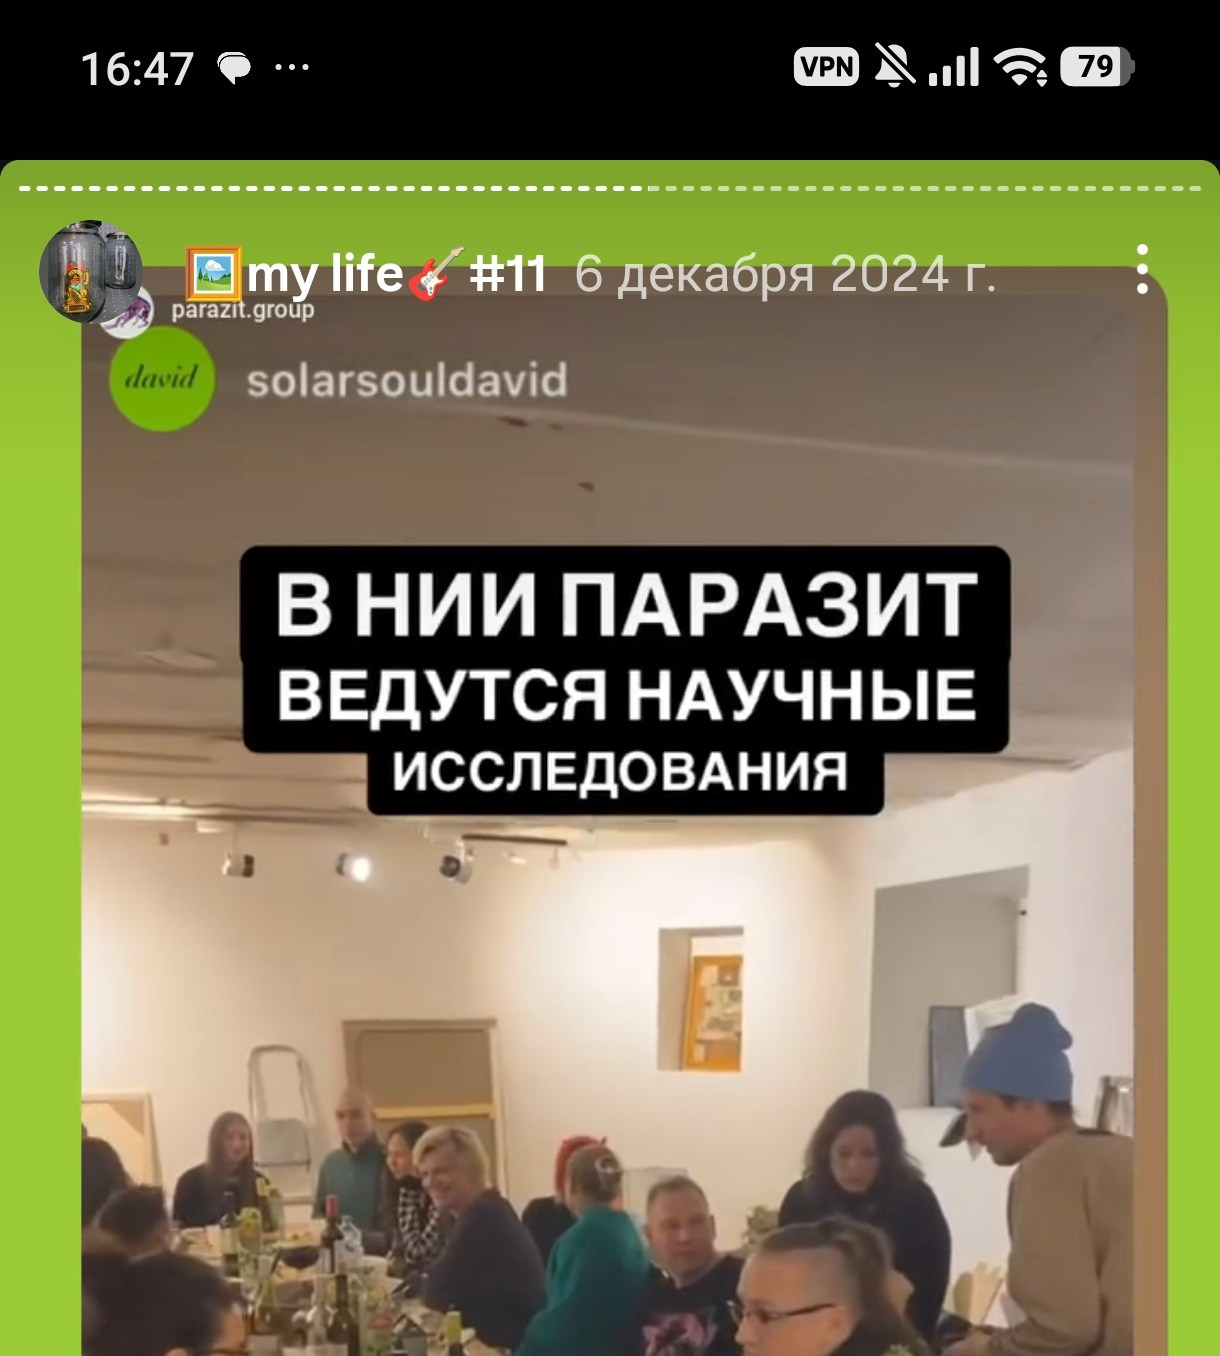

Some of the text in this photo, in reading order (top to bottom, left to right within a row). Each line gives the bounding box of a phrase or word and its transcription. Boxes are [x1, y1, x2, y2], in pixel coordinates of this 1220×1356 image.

[81, 50, 195, 88] 16:47
[800, 56, 852, 78] VPN
[1077, 53, 1114, 79] 79
[248, 252, 547, 303] my life #11
[576, 252, 997, 302] 6 декабря 2024 г.
